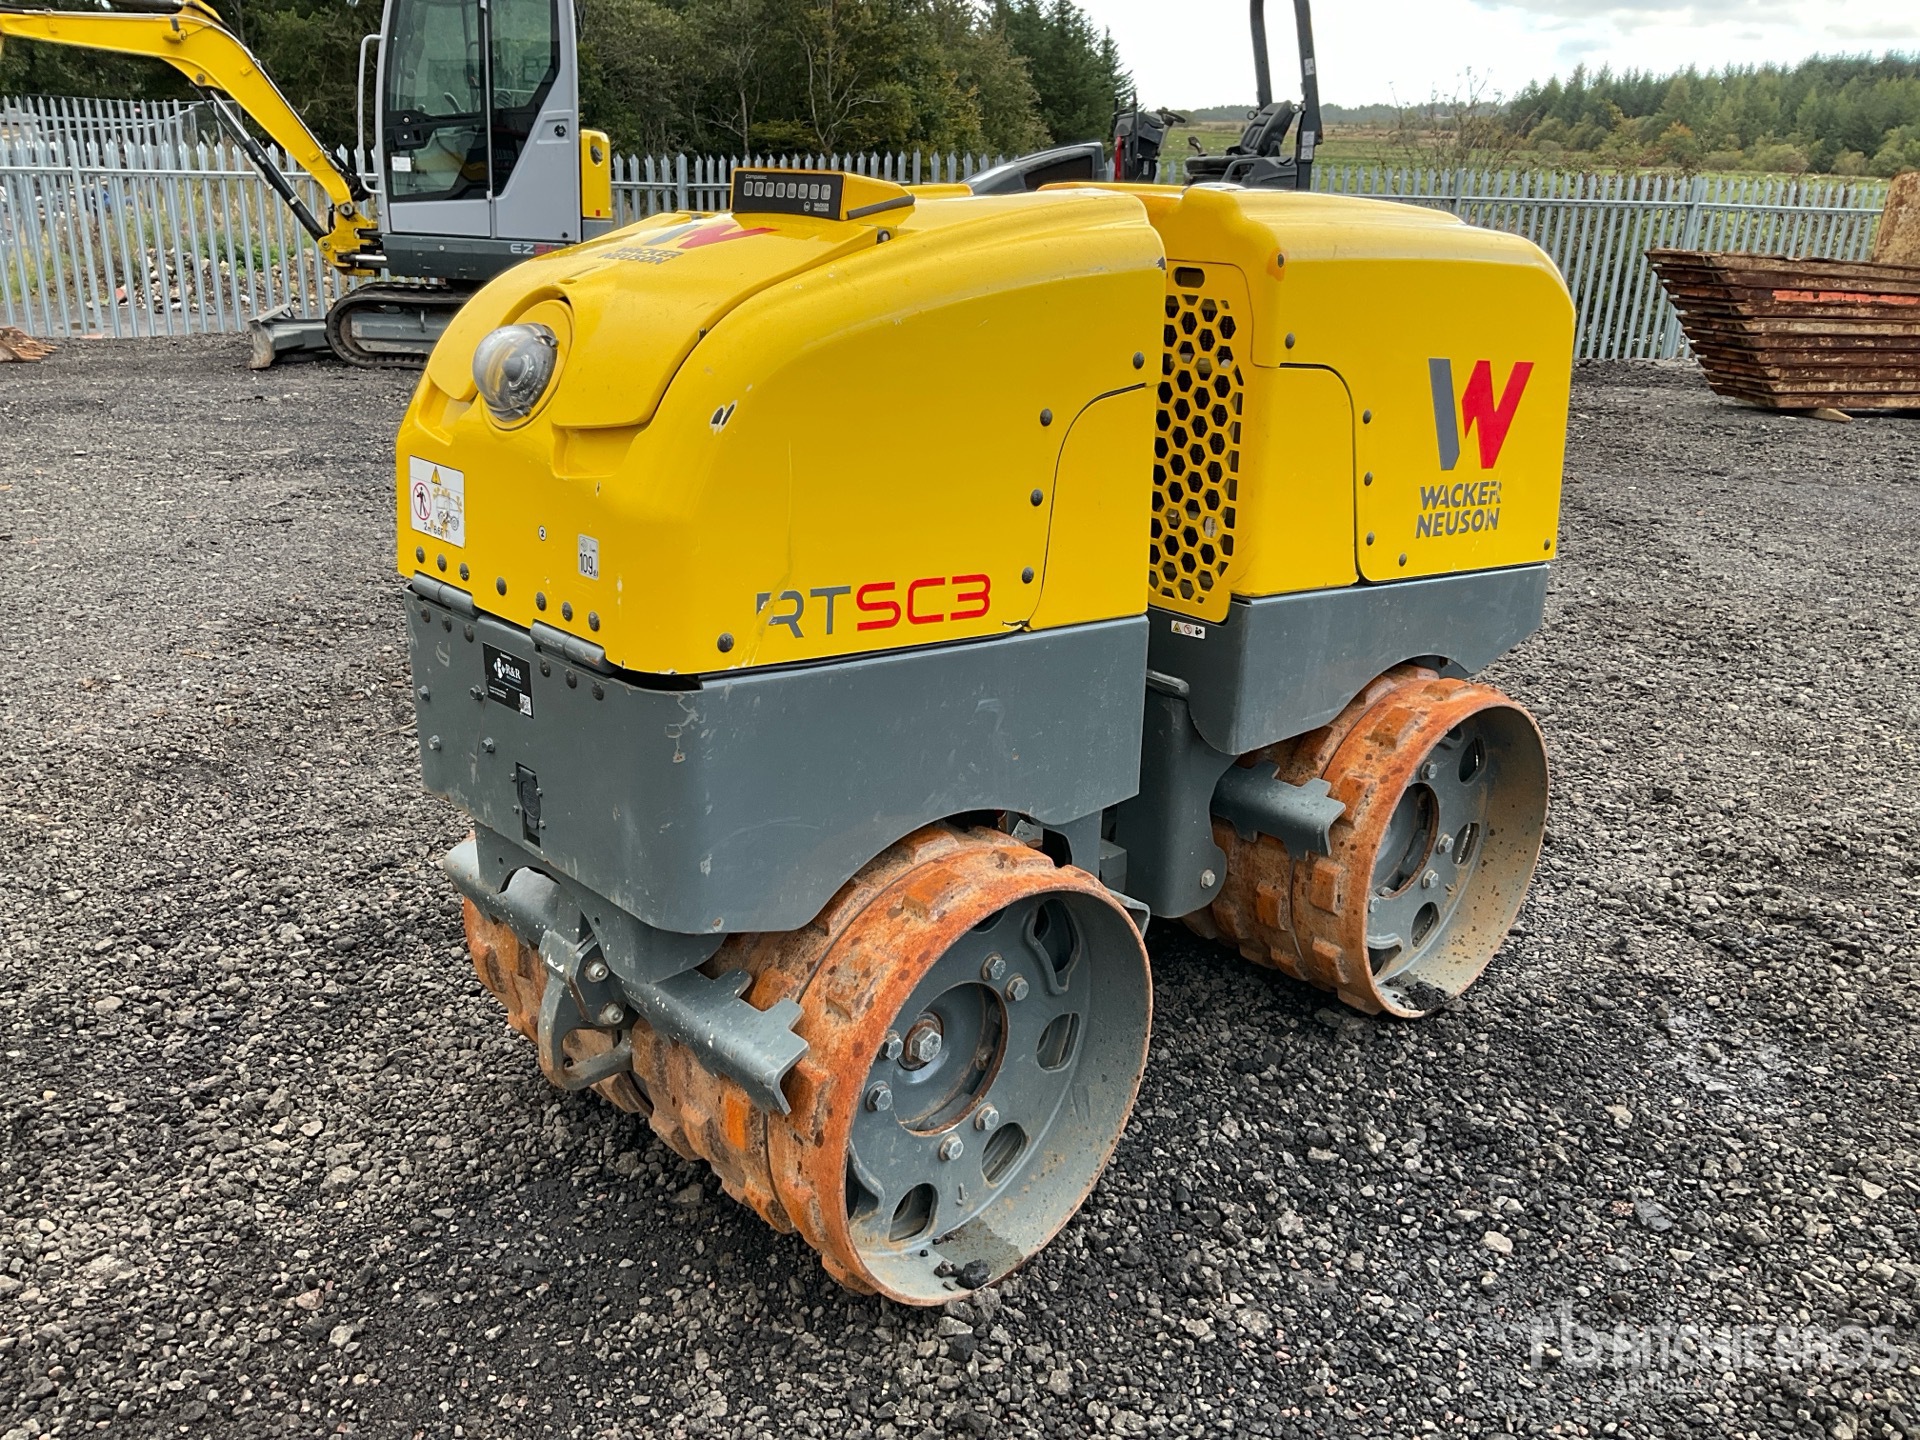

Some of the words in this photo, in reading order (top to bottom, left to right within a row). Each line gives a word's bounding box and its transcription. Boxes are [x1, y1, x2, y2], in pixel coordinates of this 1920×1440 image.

[1420, 480, 1503, 511] WACKER
[1415, 507, 1501, 539] NEUSON
[579, 552, 594, 575] 109
[756, 573, 991, 639] RTSC3
